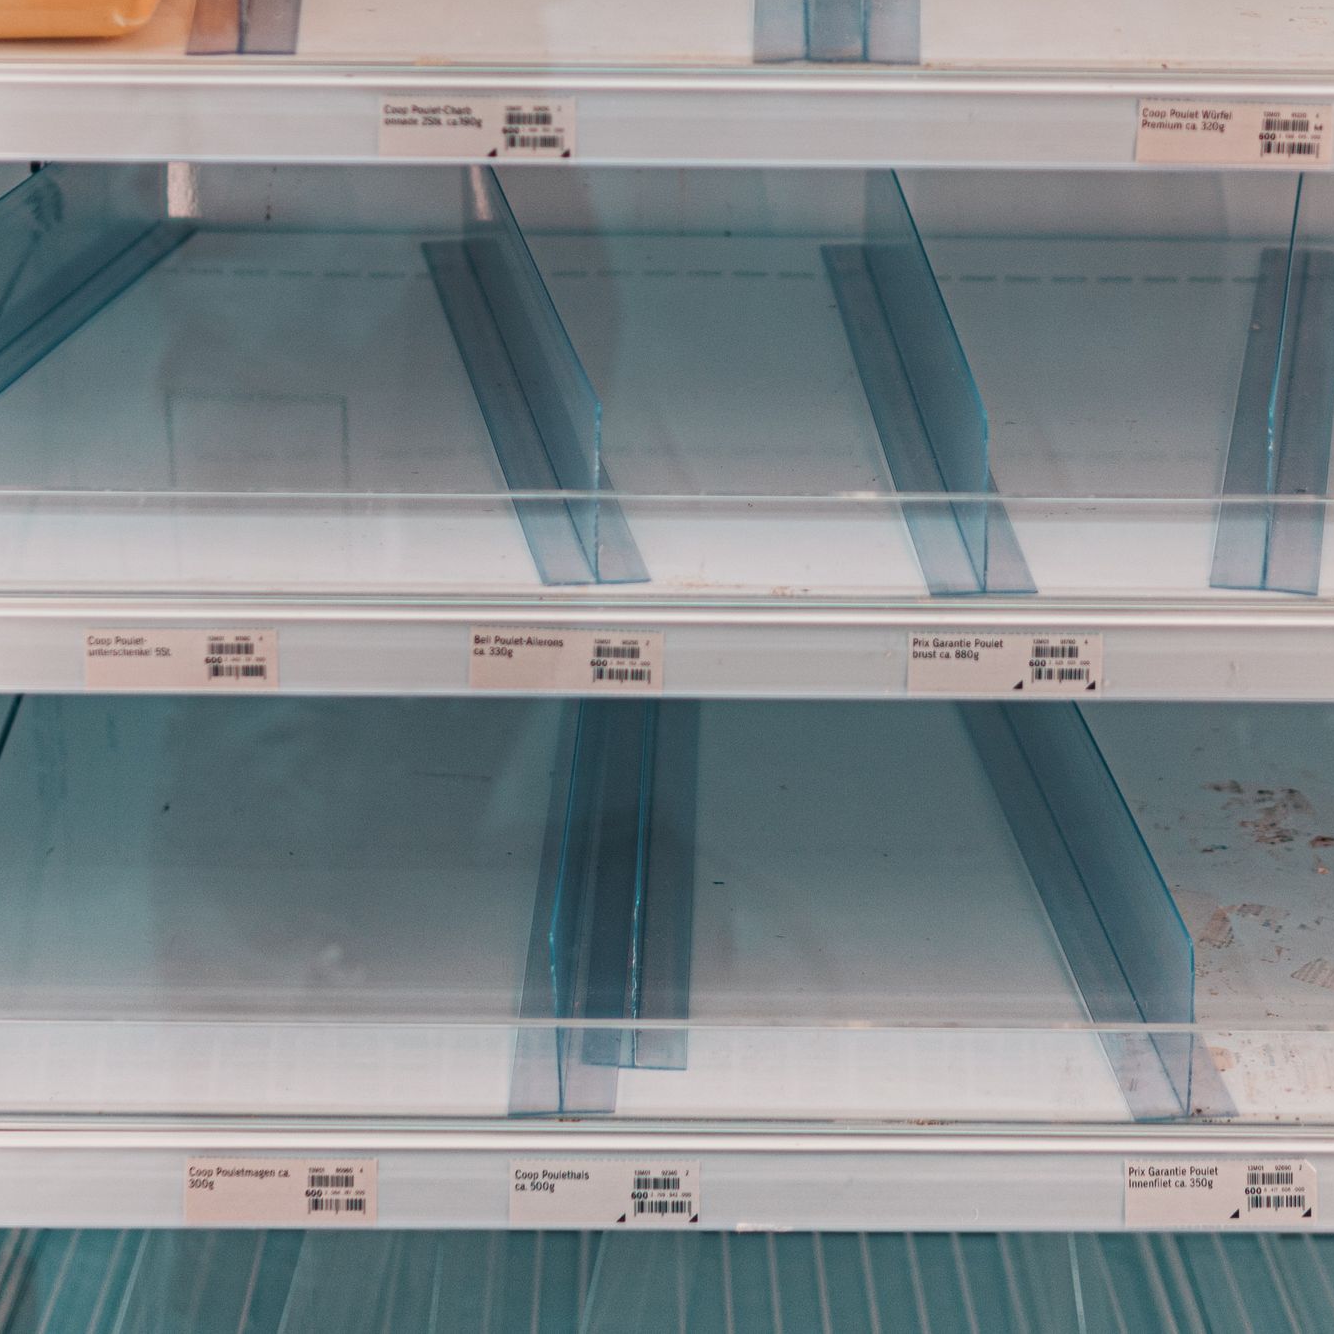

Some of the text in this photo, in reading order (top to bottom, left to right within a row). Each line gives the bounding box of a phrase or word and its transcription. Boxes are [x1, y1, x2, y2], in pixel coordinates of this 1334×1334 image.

[1142, 108, 1198, 119] Coop Poulet
[1142, 120, 1225, 133] Premium 320g
[87, 636, 112, 646] Coop
[494, 635, 564, 647] Poulet-Ailerons
[912, 638, 1003, 648] Prix Garantie Poulet
[489, 647, 513, 658] 330g
[912, 649, 979, 661] brust ca. 880g
[1029, 659, 1046, 667] 600
[189, 1167, 275, 1179] Coop Pouletmagen
[515, 1170, 589, 1180] Coop Poulethals
[1129, 1166, 1219, 1176] Prix Garantie Poulet
[515, 1181, 555, 1192] ca. 500g
[1129, 1178, 1213, 1189] Innenfilet ca. 350g
